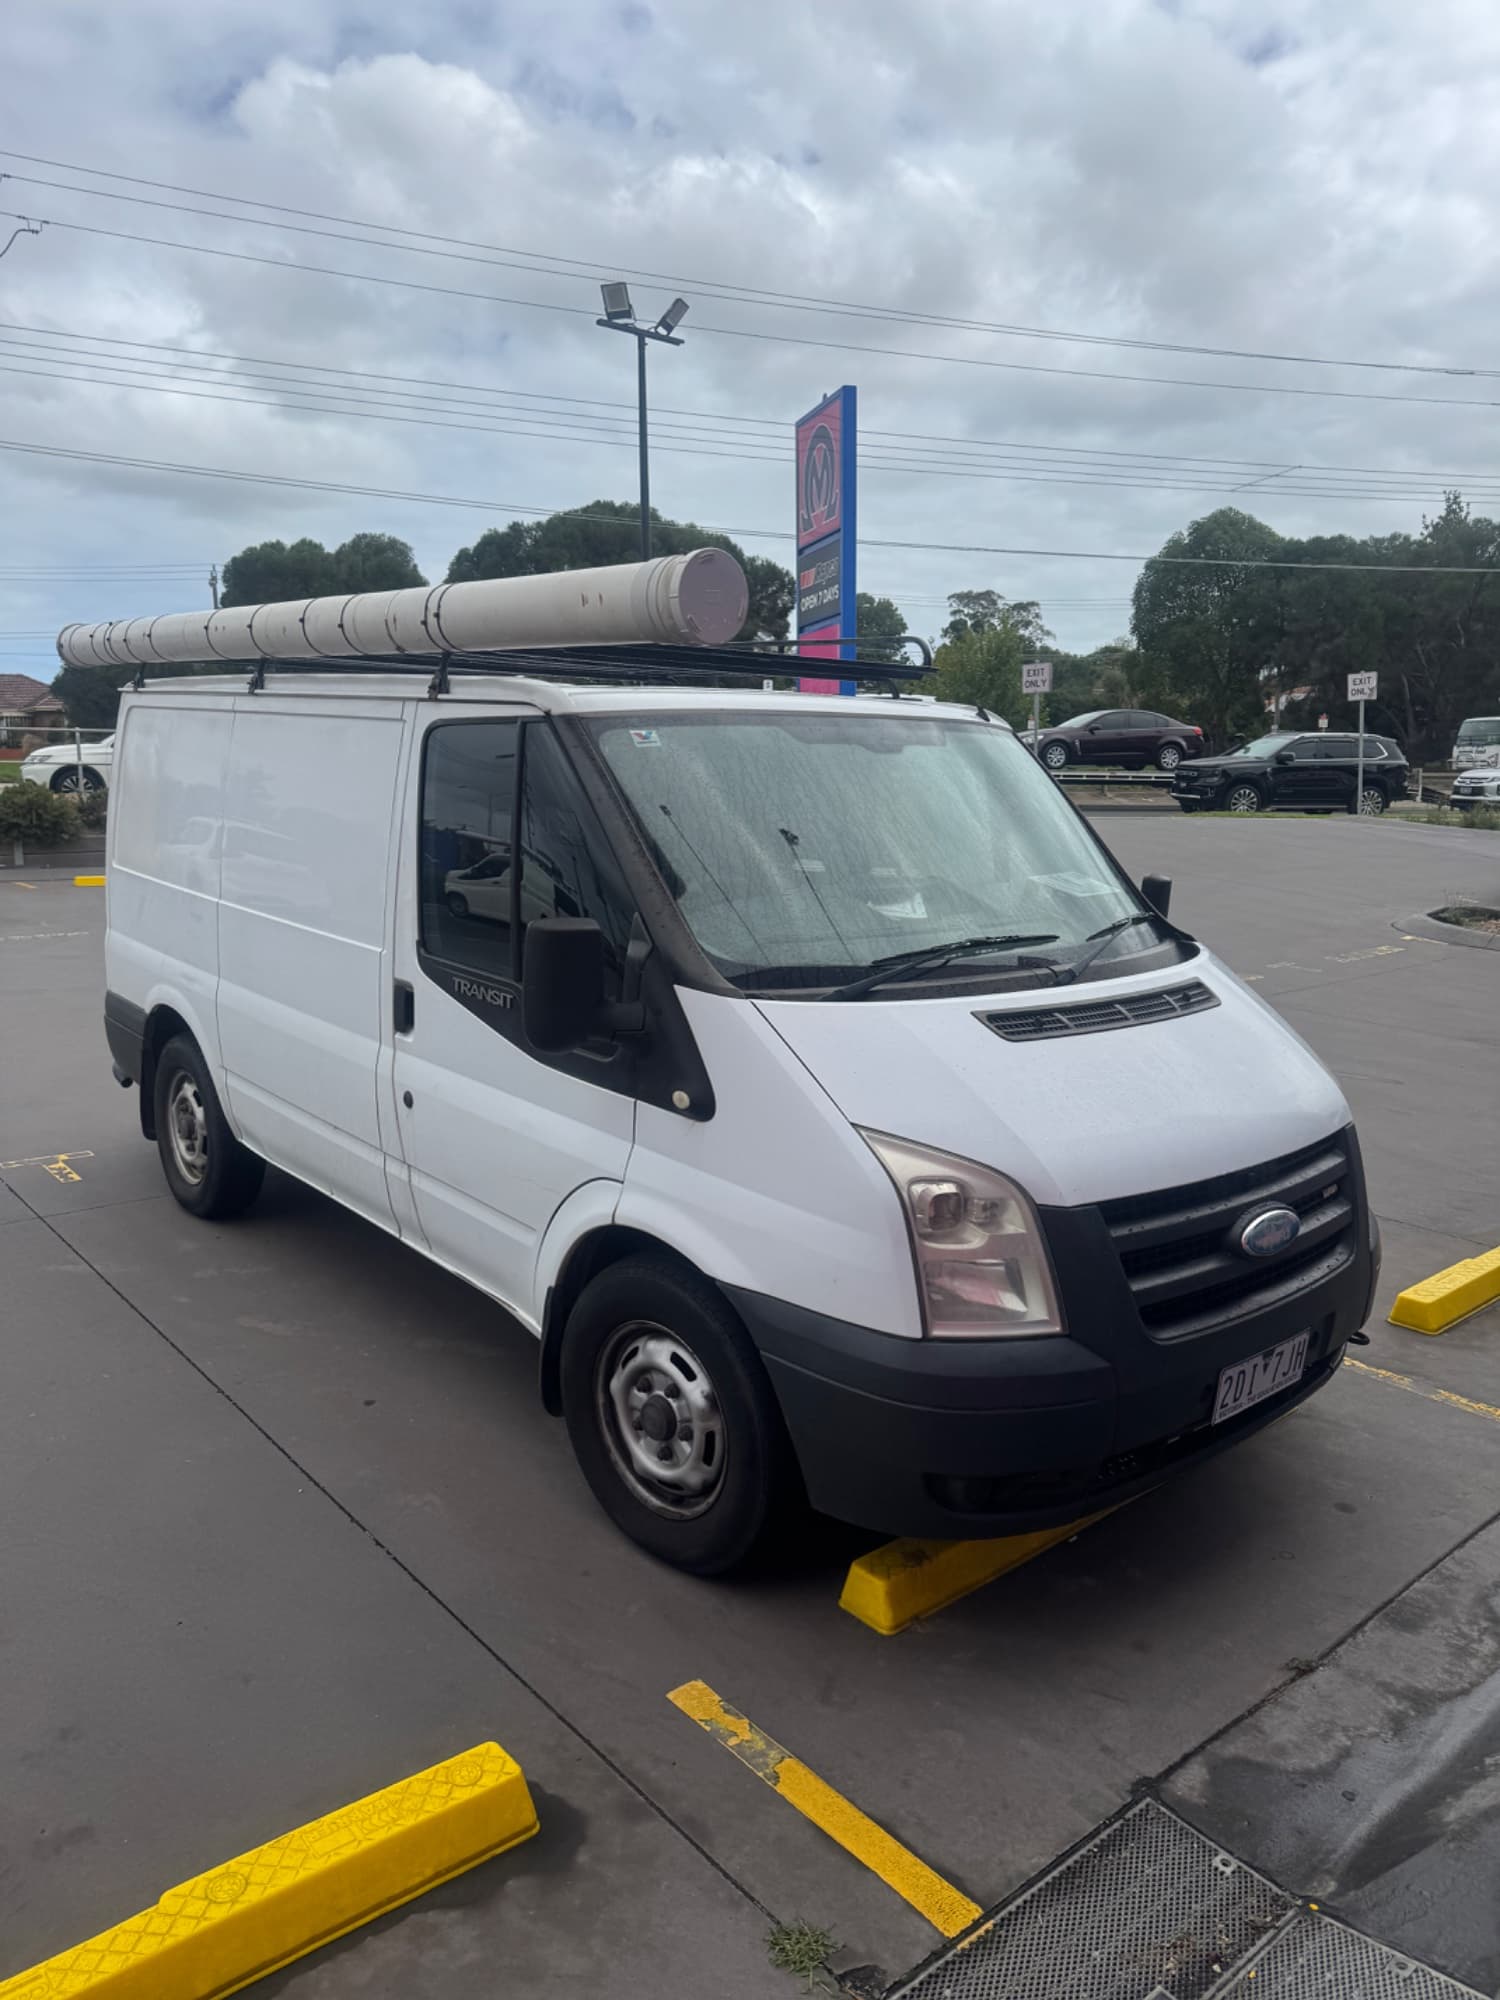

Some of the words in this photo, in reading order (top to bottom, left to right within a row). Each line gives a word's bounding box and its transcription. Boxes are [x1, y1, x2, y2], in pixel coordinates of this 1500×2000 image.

[800, 594, 818, 612] OPEN
[823, 584, 839, 604] DAYS
[1027, 668, 1045, 677] EXIT
[1024, 679, 1047, 689] ONLY
[1352, 676, 1372, 686] EXIT
[1351, 687, 1375, 697] ONLY
[452, 976, 514, 1009] TRANSIT
